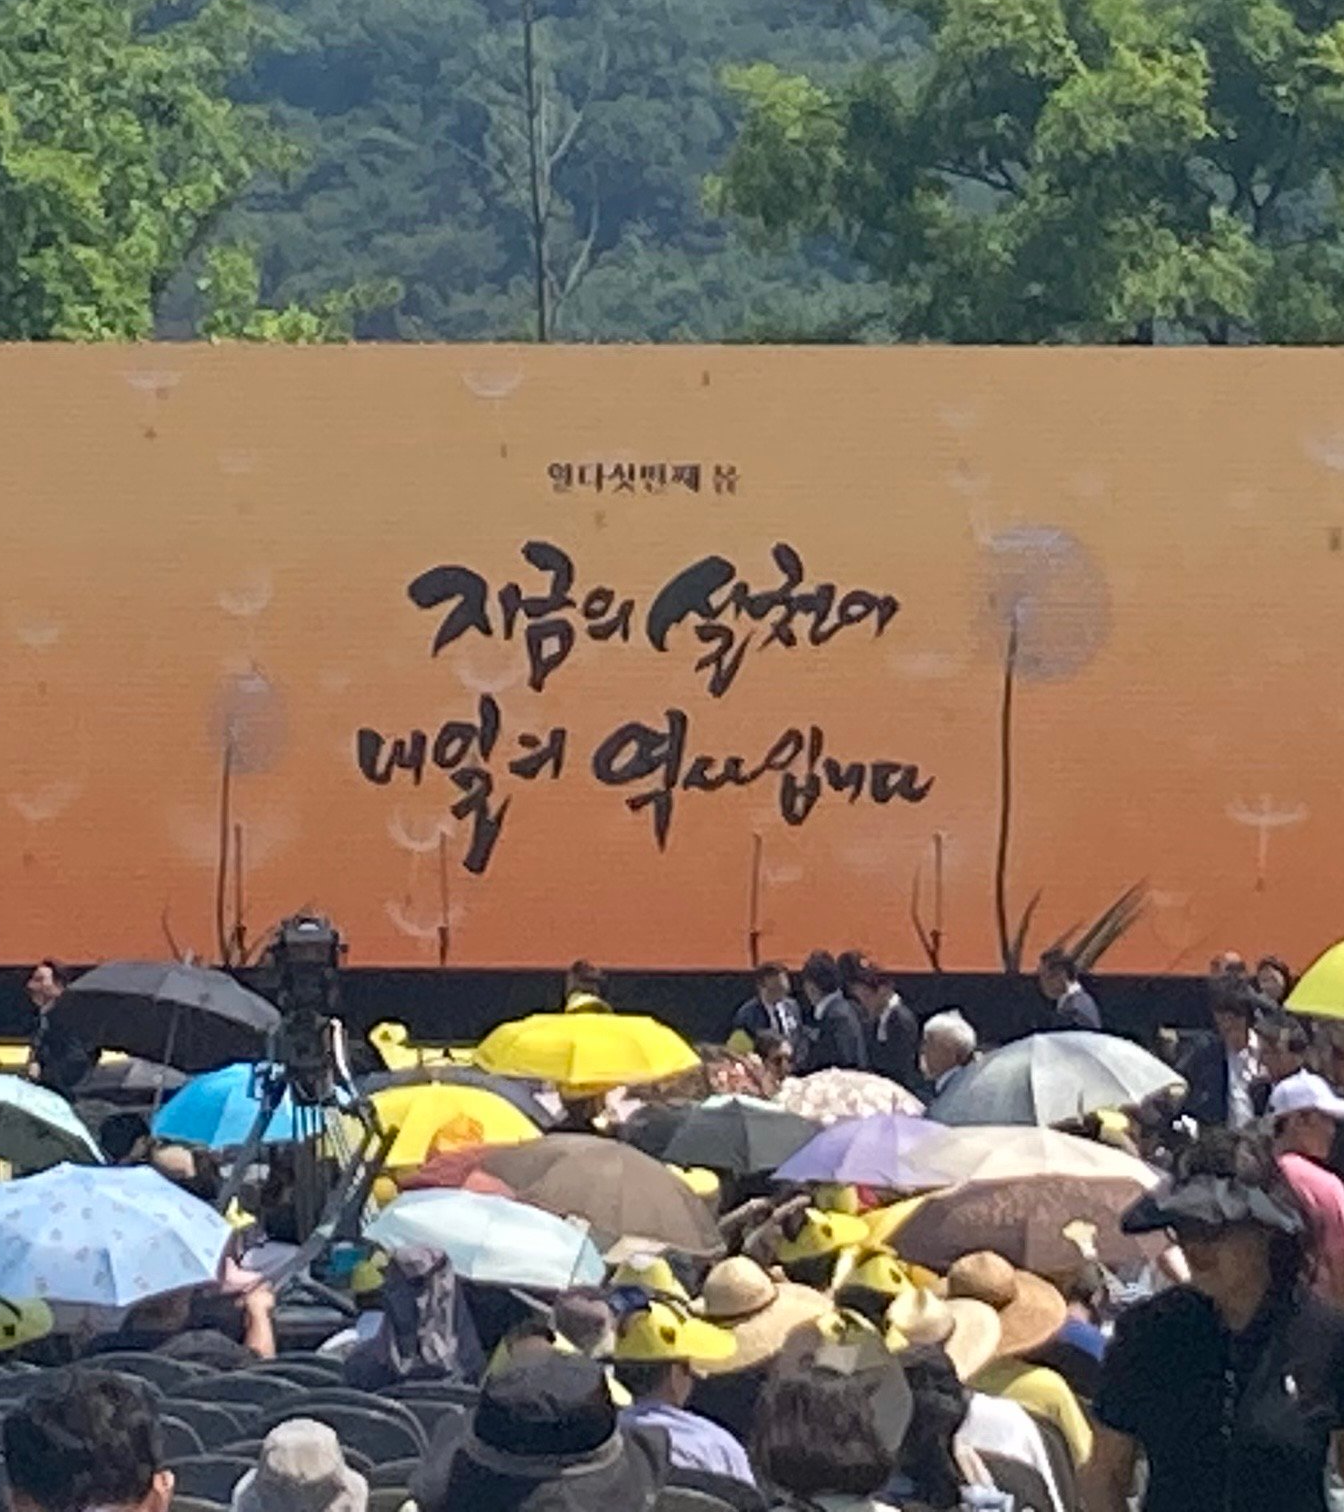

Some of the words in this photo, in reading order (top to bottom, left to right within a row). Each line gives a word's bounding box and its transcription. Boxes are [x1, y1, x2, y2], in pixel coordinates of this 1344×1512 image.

[408, 541, 634, 692] 지금의
[646, 542, 899, 697] 실천이
[358, 694, 566, 874] 내일의
[592, 708, 935, 854] 역사입니다
